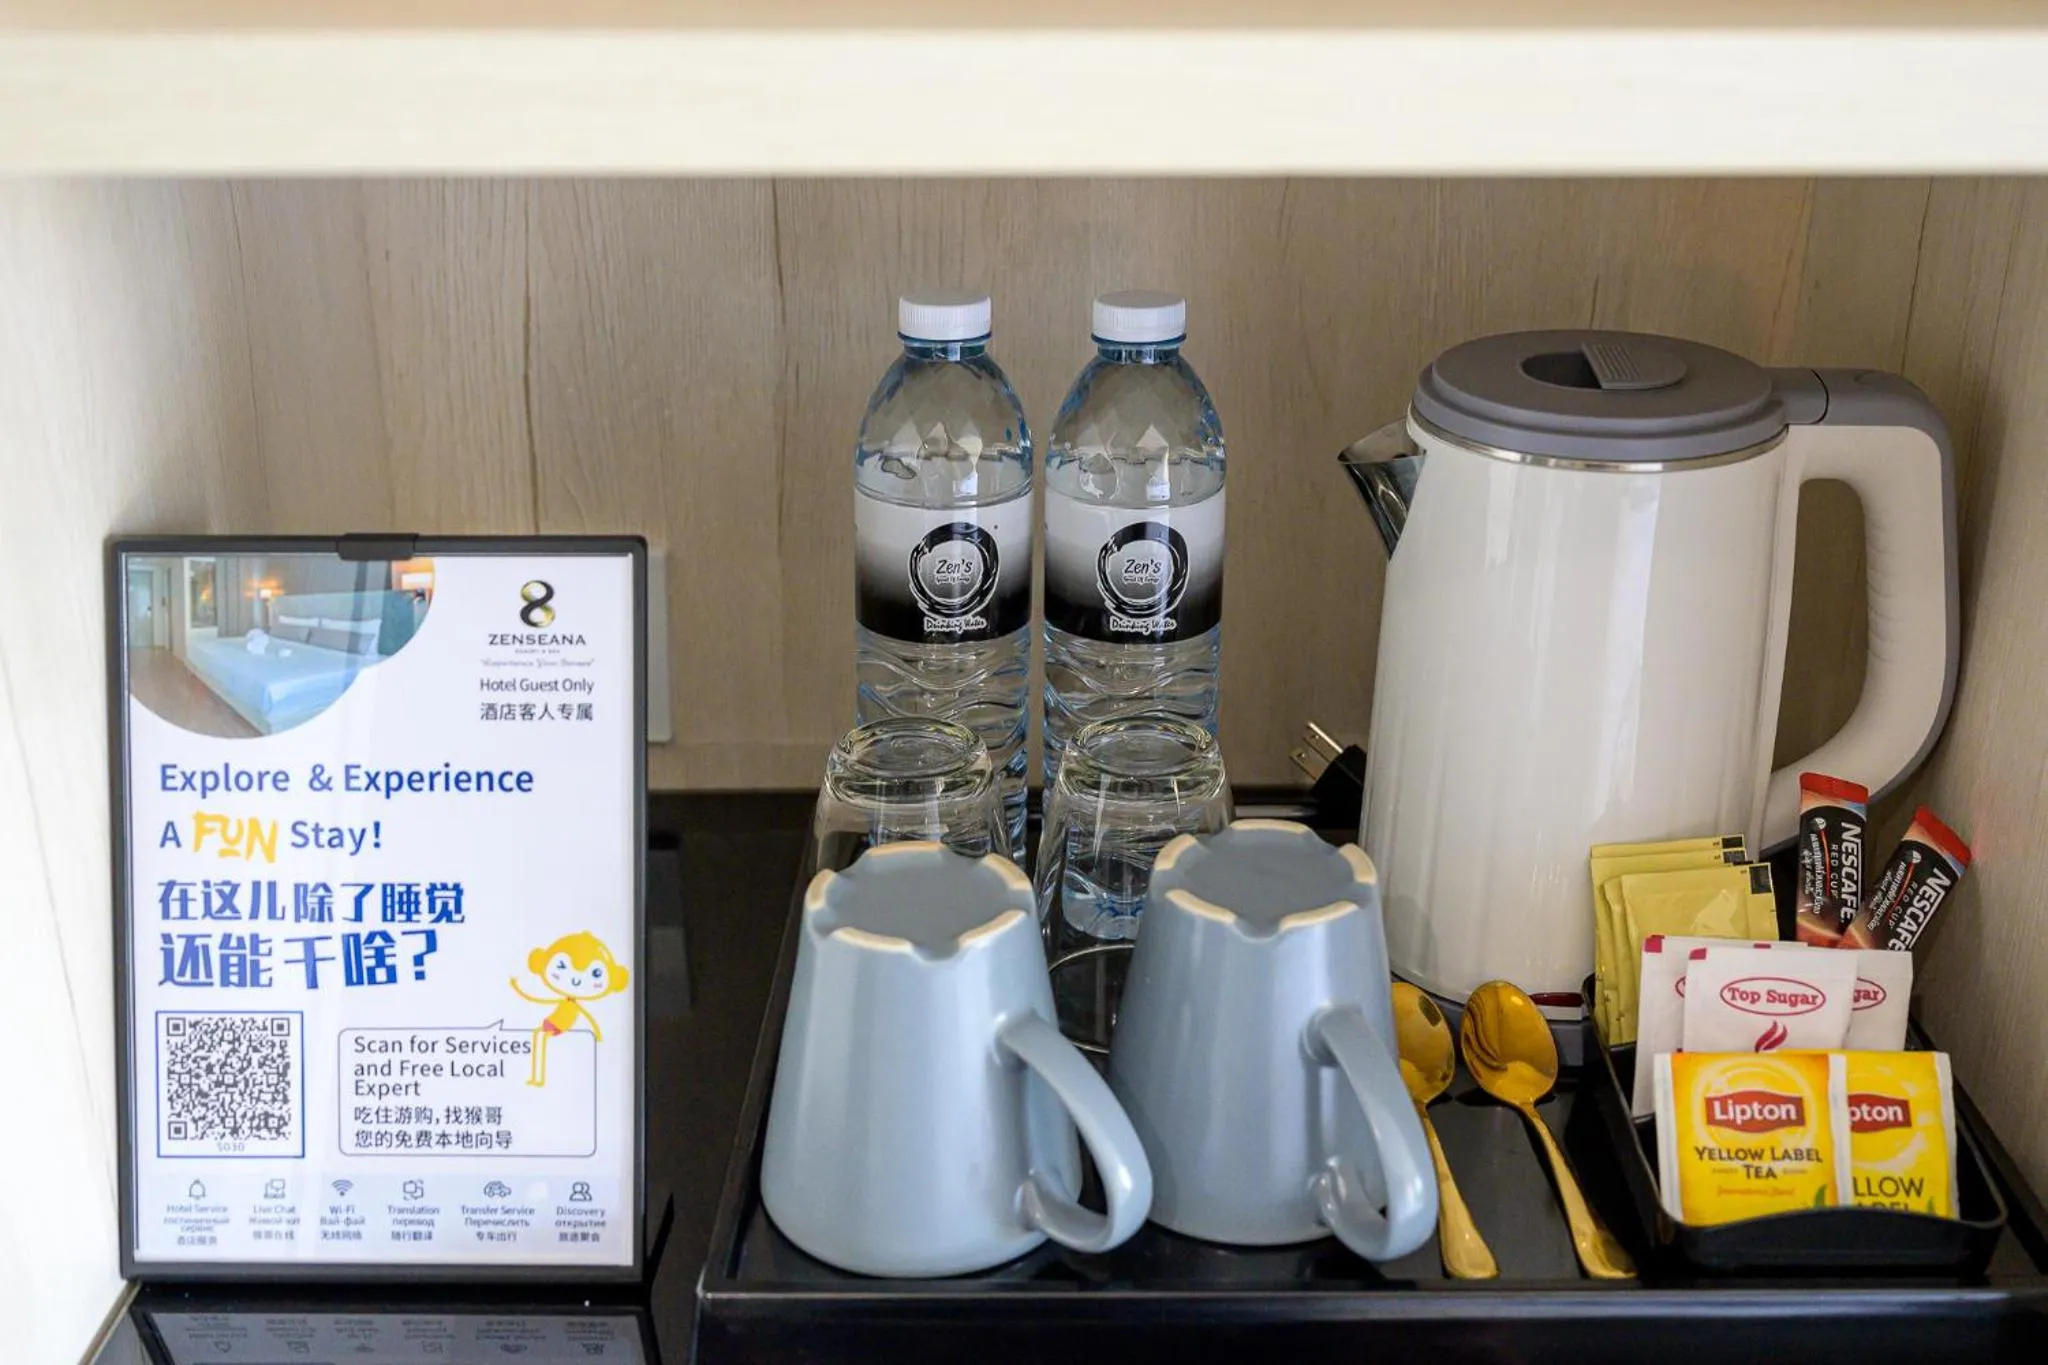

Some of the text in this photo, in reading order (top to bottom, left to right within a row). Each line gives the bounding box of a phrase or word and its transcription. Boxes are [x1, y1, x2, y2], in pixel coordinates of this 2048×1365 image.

[936, 558, 973, 575] Zen's
[1124, 558, 1161, 575] Zen's
[488, 633, 587, 646] ZENSEANA
[480, 678, 595, 695] Hotel Guest Only
[480, 702, 593, 722] 酒店客人专属
[160, 762, 534, 799] Explore & Experience
[160, 810, 382, 863] A FUN Stay!
[1830, 843, 1839, 867] RED
[157, 879, 466, 923] 在这儿除了睡觉
[1727, 986, 1820, 1008] Top Sugar
[1852, 988, 1881, 1003] gar
[354, 1035, 531, 1055] Scan for Services
[354, 1059, 504, 1077] and Free Local
[354, 1079, 421, 1100] Expert
[1712, 1100, 1798, 1125] Lipton
[1848, 1103, 1904, 1125] pton
[355, 1129, 513, 1150] 您的免费本地向导
[1694, 1145, 1823, 1163] YELLOW LABEL
[1743, 1164, 1777, 1180] TEA
[1852, 1176, 1925, 1198] LLOW
[166, 1204, 229, 1214] Hotel Service
[274, 1204, 296, 1215] Chat
[387, 1204, 440, 1215] Translation
[461, 1204, 536, 1215] Transfer Service
[556, 1205, 606, 1218] Discovery
